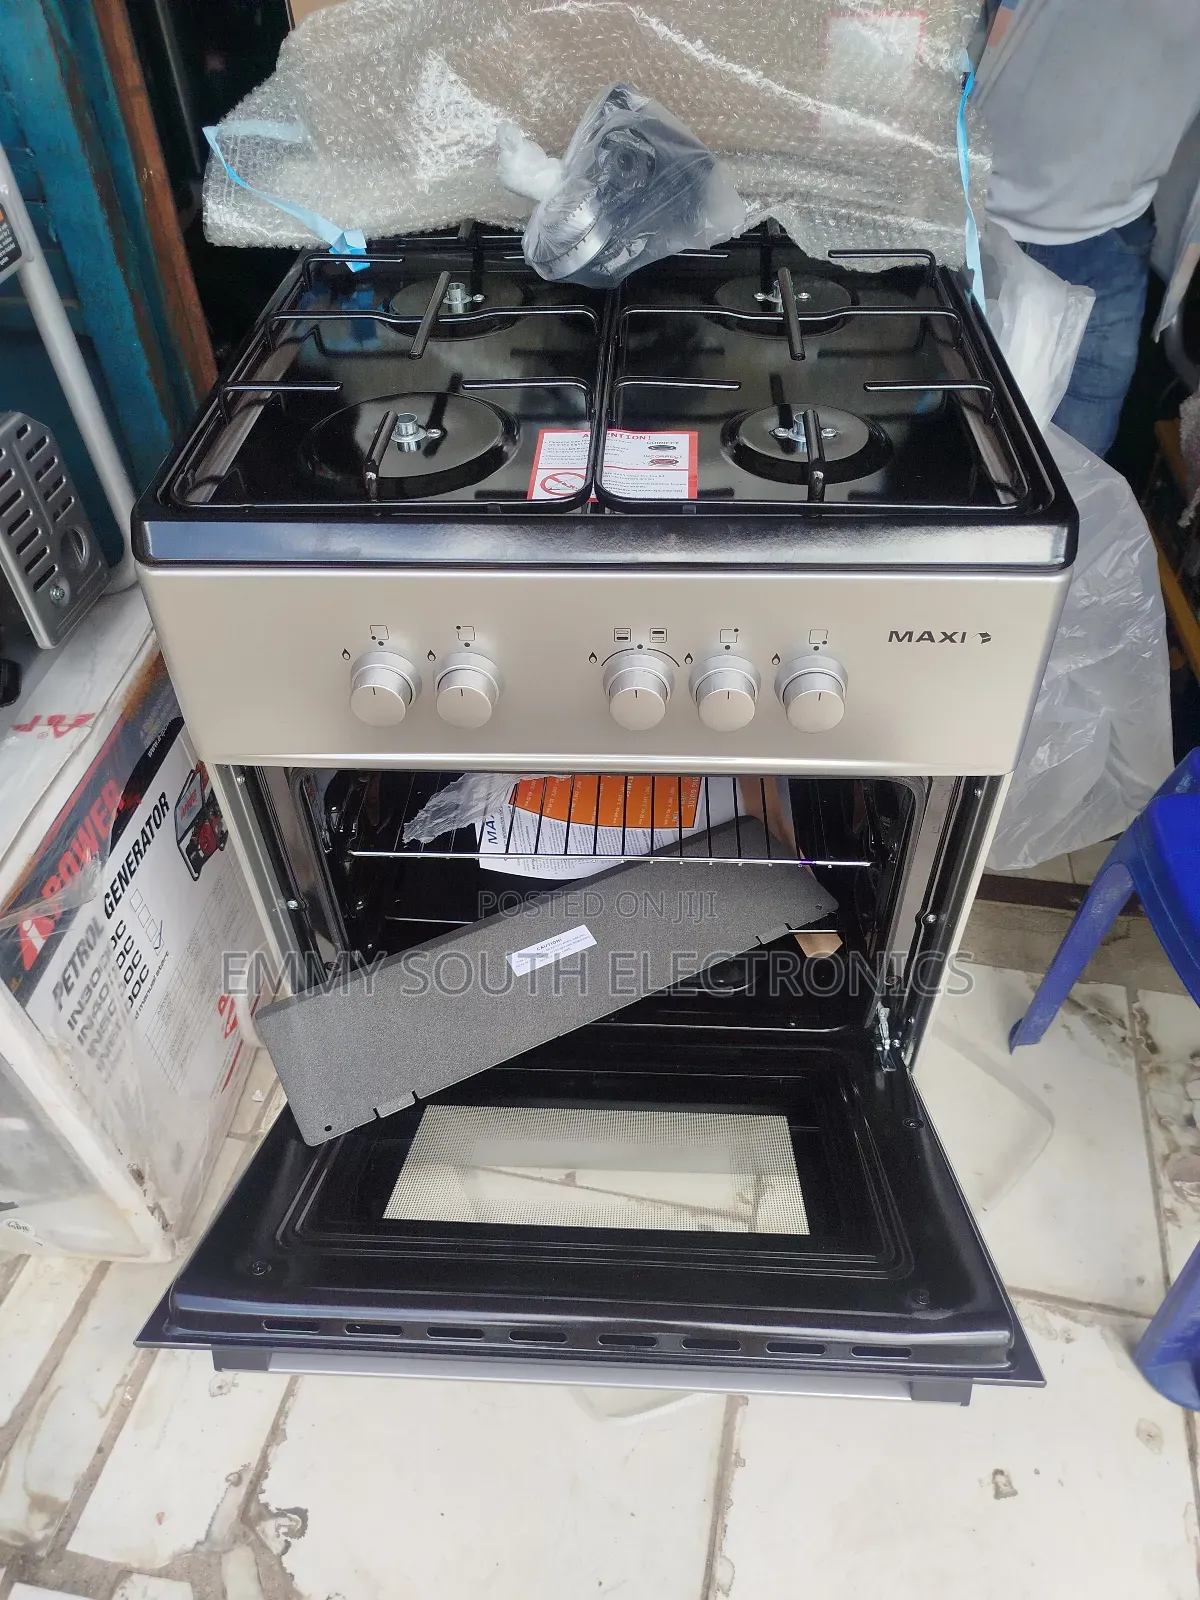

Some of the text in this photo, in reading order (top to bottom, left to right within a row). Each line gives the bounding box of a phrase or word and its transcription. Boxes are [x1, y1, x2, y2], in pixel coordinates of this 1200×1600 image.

[887, 630, 967, 644] MAXI
[486, 815, 498, 845] MA
[52, 791, 170, 1013] PETROL GENERATOR
